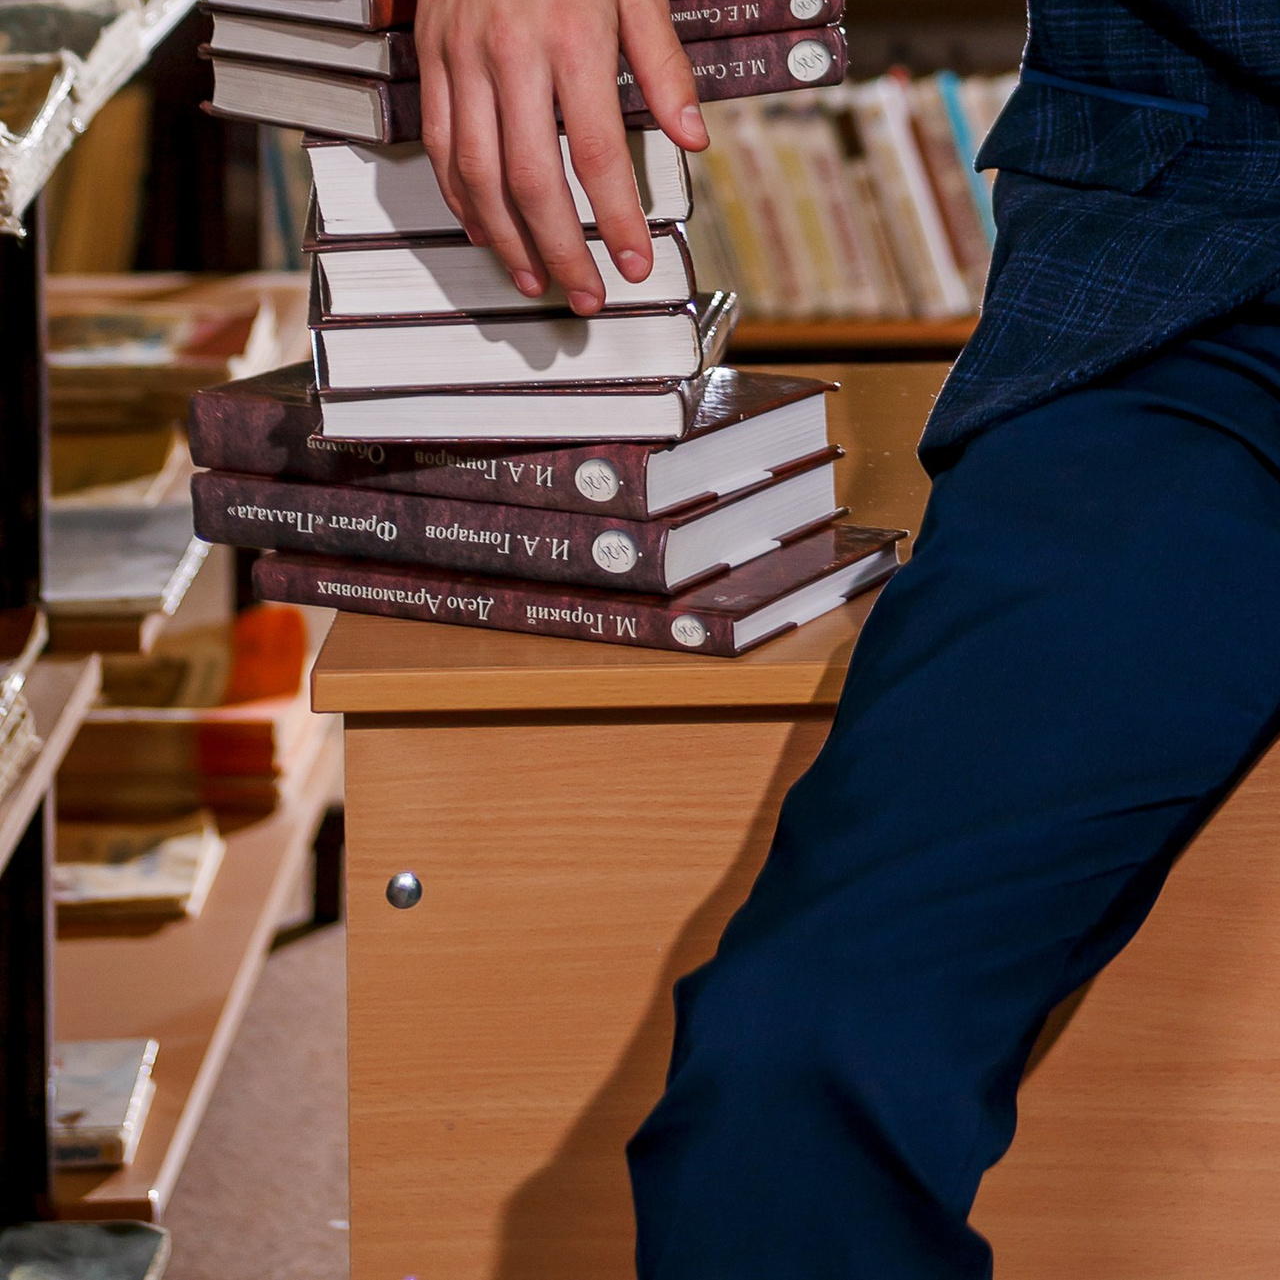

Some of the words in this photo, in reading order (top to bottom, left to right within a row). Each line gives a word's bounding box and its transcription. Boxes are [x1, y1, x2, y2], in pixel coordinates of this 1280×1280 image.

[724, 4, 738, 22] Е.
[741, 3, 759, 19] М.
[730, 60, 744, 78] Е.
[748, 59, 766, 75] М.
[306, 438, 385, 464] Обломов
[415, 448, 497, 481] Гончаров
[503, 460, 525, 483] А.
[531, 464, 554, 487] И.
[226, 504, 324, 534] «Паллада»
[329, 515, 398, 542] Фрегат
[425, 523, 511, 555] Гончаров
[516, 534, 541, 557] А.
[546, 538, 570, 561] И.
[317, 580, 443, 615] Артамоновых
[447, 595, 495, 621] Дело
[526, 605, 604, 635] Горький
[609, 615, 637, 639] М.
